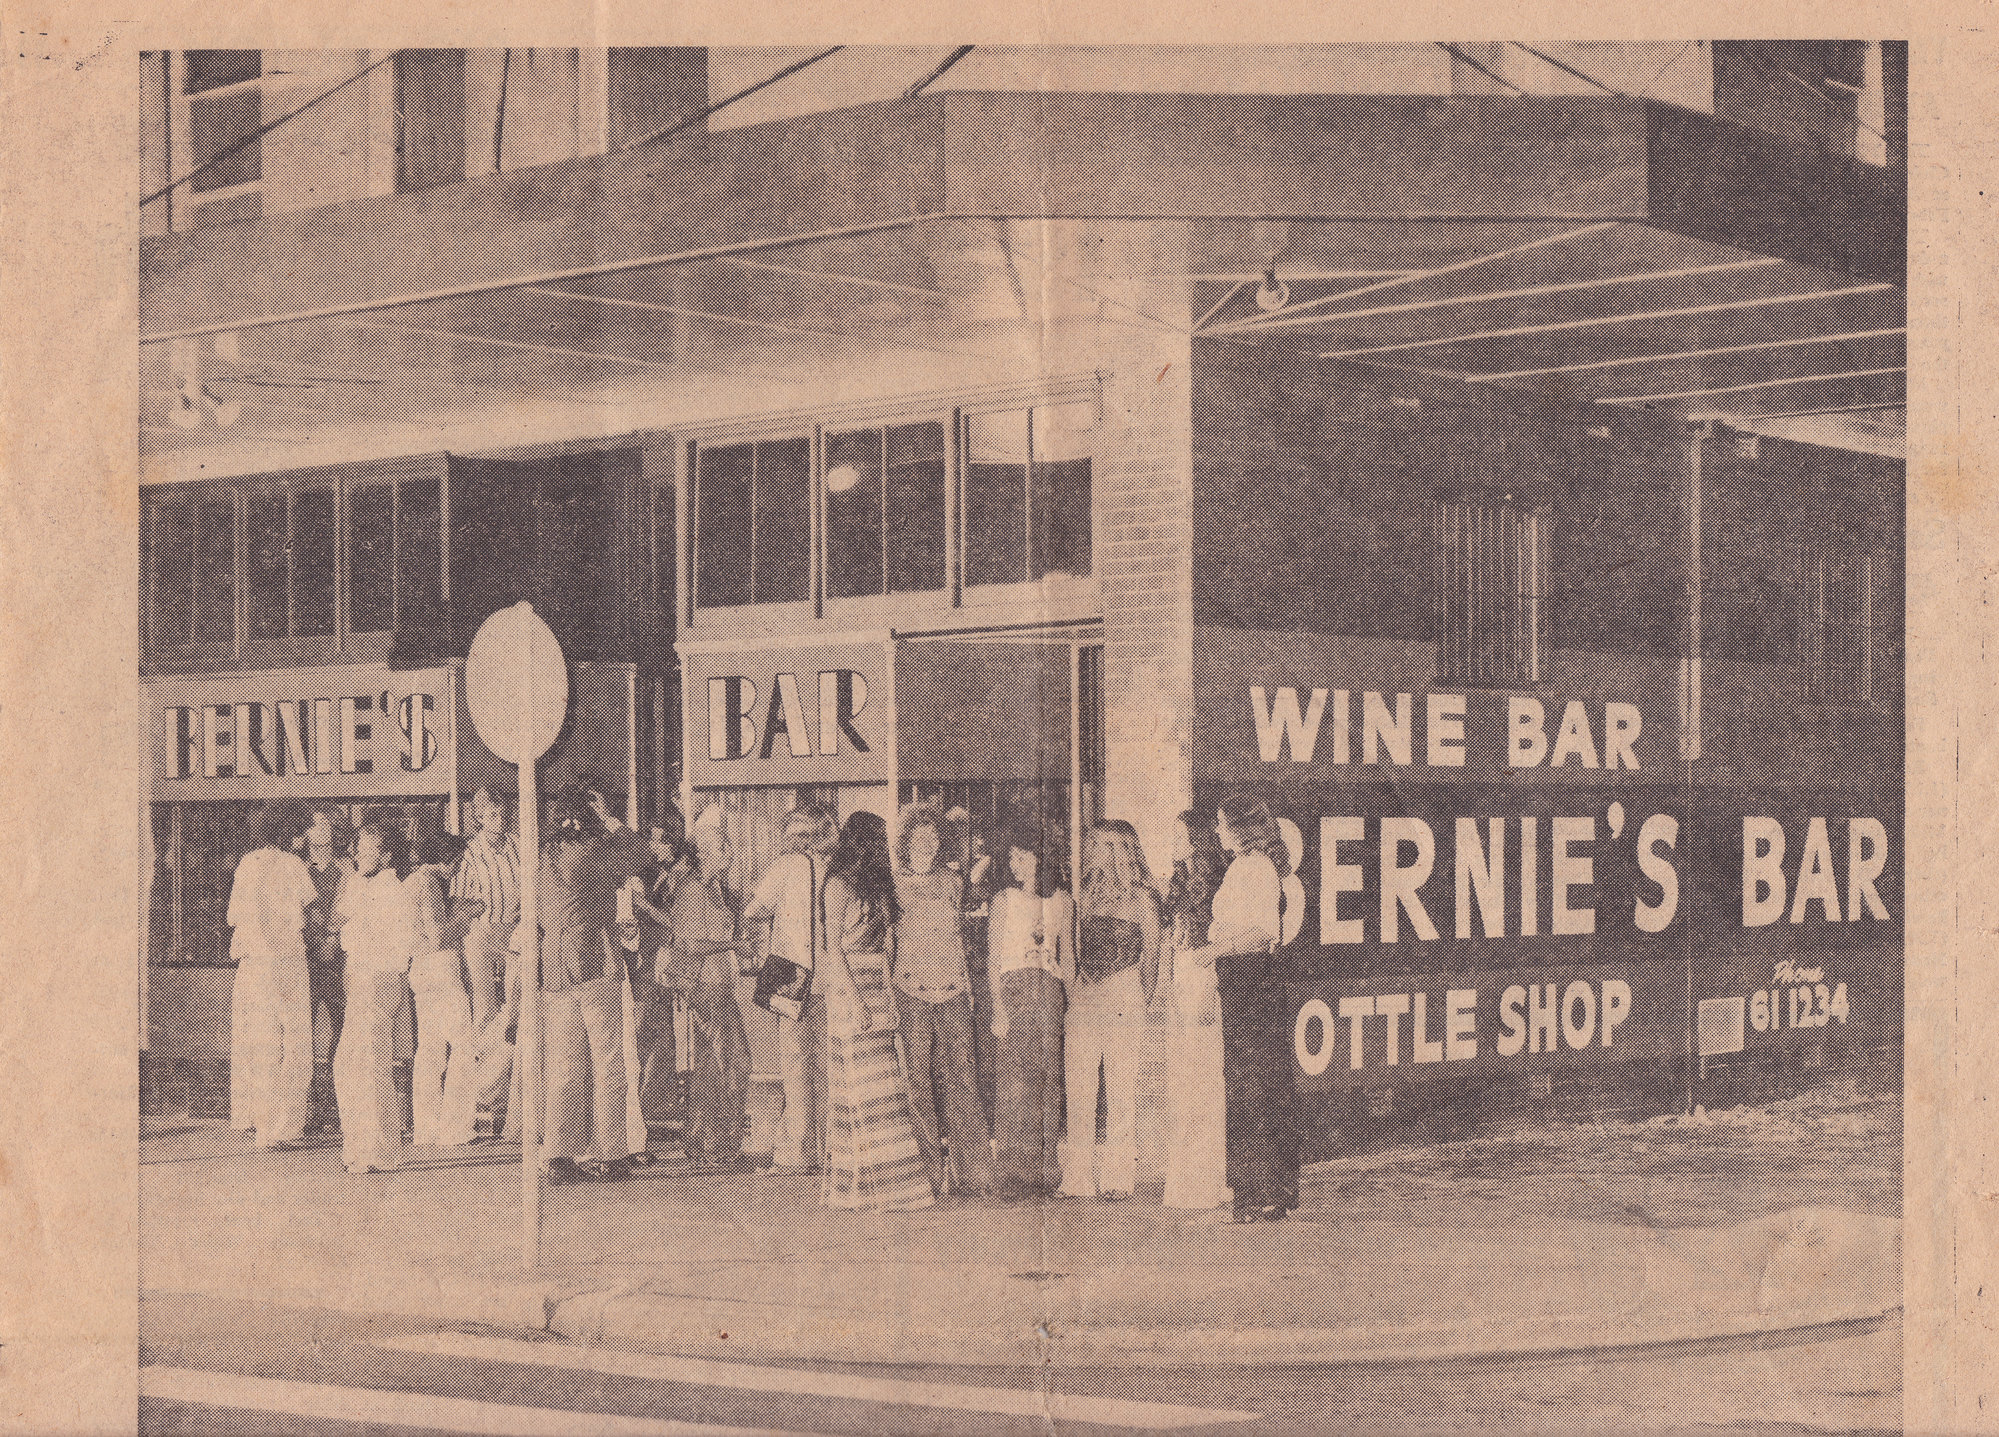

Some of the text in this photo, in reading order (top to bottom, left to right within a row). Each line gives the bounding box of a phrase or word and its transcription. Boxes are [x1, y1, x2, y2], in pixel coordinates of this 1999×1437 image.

[164, 691, 439, 780] BERNIE'S
[707, 670, 870, 760] BAR
[1250, 686, 1642, 770] WINE BAR
[1741, 815, 1891, 928] BAR
[1294, 980, 1632, 1076] OTTLE SHOP
